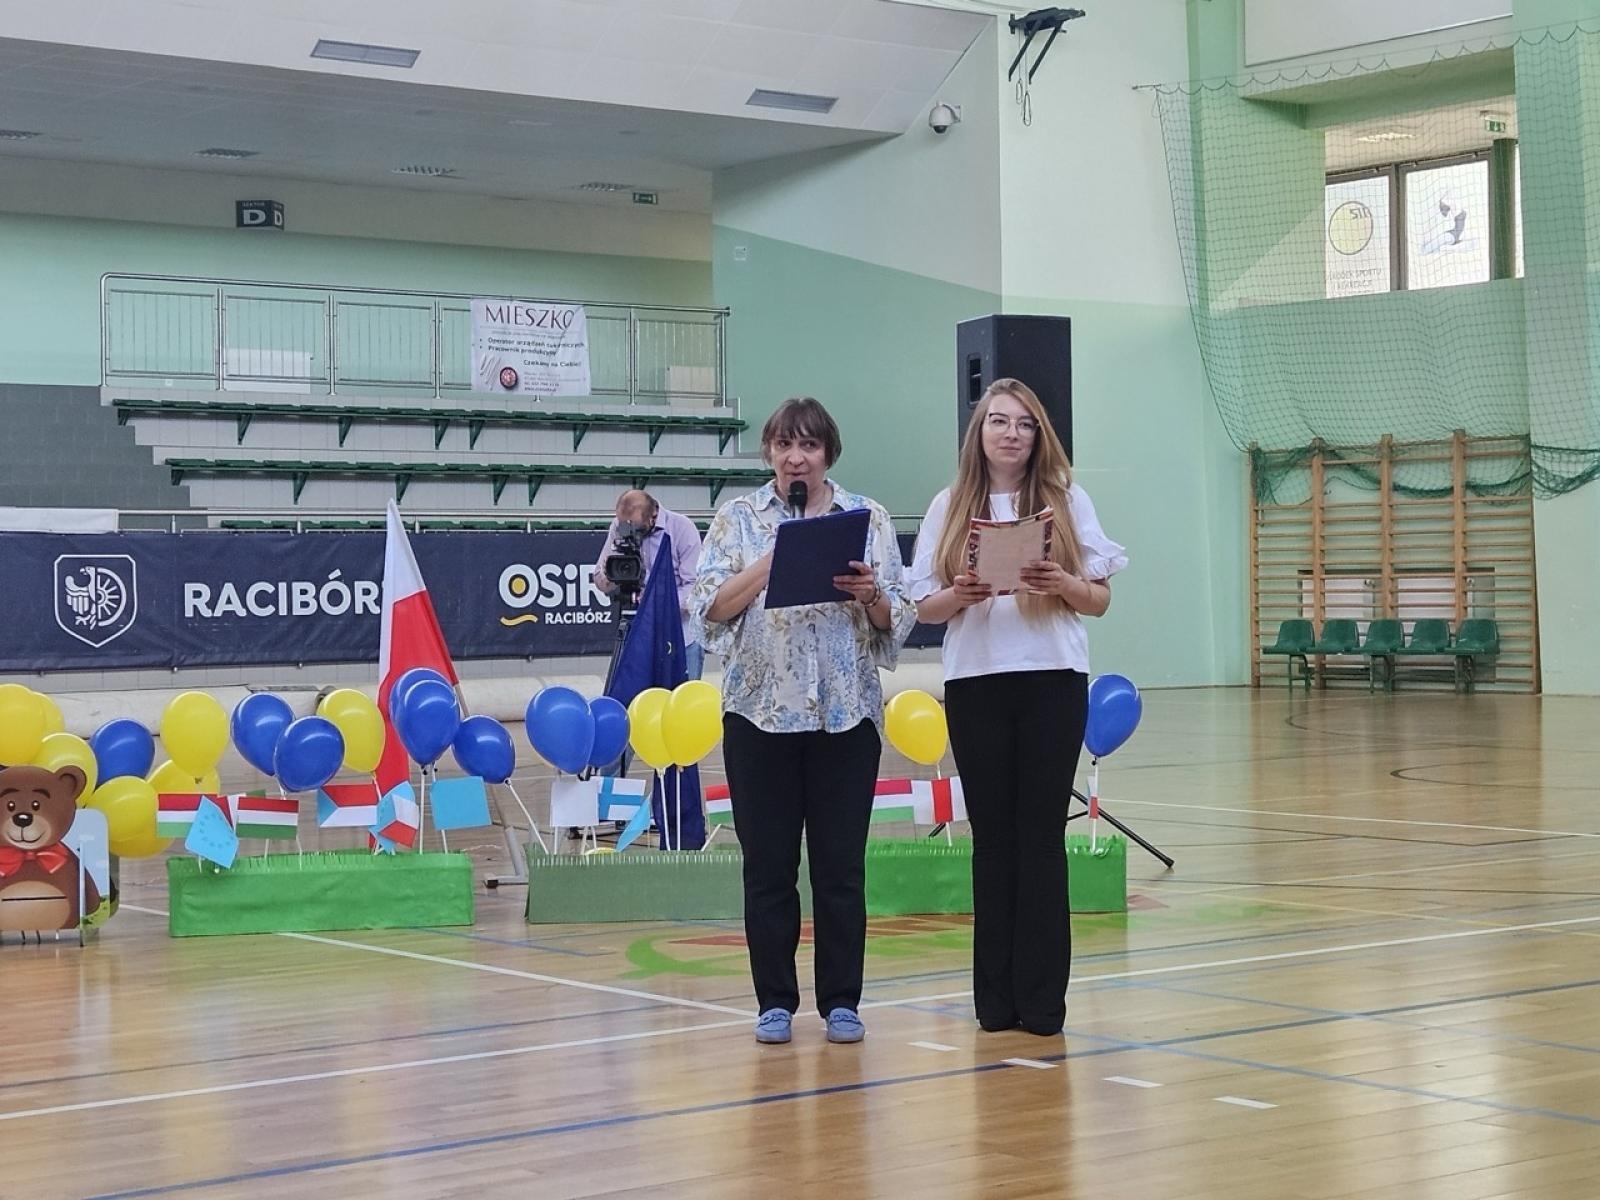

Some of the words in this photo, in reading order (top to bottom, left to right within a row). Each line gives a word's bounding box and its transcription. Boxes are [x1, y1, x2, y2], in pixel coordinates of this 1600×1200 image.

[243, 209, 266, 225] D
[274, 210, 283, 226] D
[485, 304, 575, 331] MIESZKO
[488, 337, 515, 345] Operator
[184, 568, 383, 618] RACIBÓR
[498, 563, 612, 608] OSiR
[545, 608, 612, 625] RACIBÓRZ
